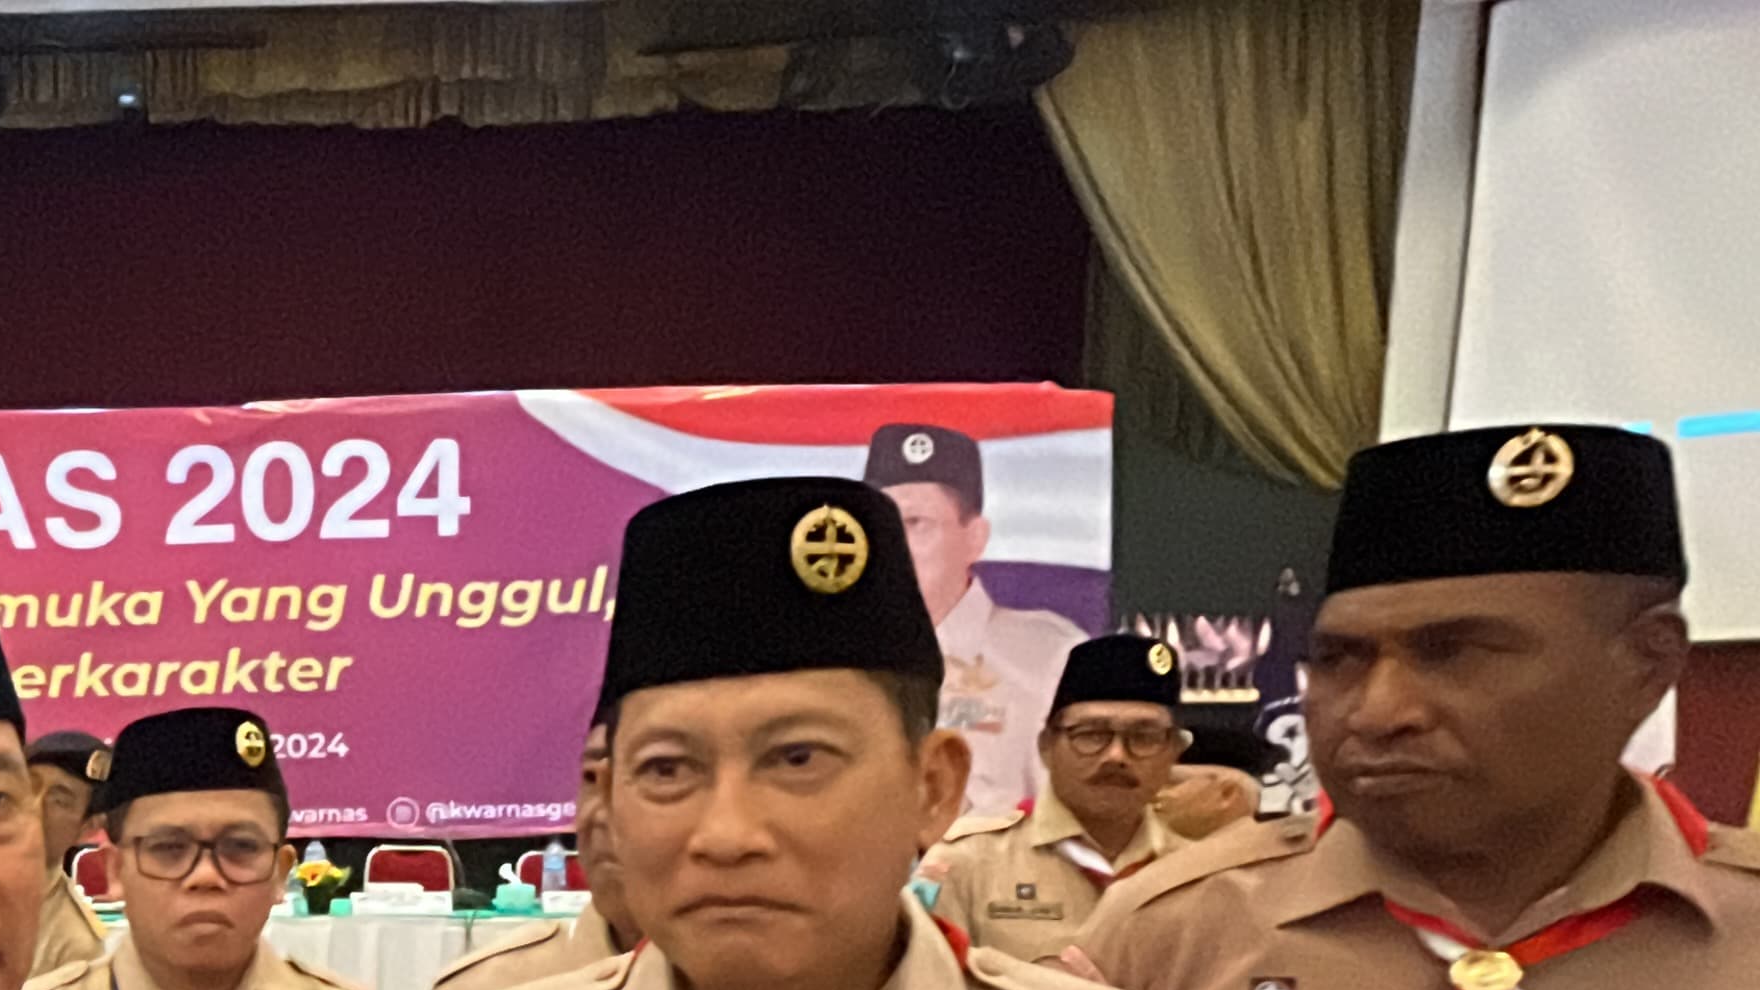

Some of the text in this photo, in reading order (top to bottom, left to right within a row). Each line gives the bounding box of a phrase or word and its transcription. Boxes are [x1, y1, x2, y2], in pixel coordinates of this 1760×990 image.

[165, 437, 471, 545] 2024
[185, 577, 347, 631] Yang
[369, 564, 616, 628] Unggul,
[11, 646, 353, 700] erkarakter
[270, 732, 350, 759] 2024
[289, 807, 369, 824] warnas
[425, 799, 578, 824] @kwarnasge
